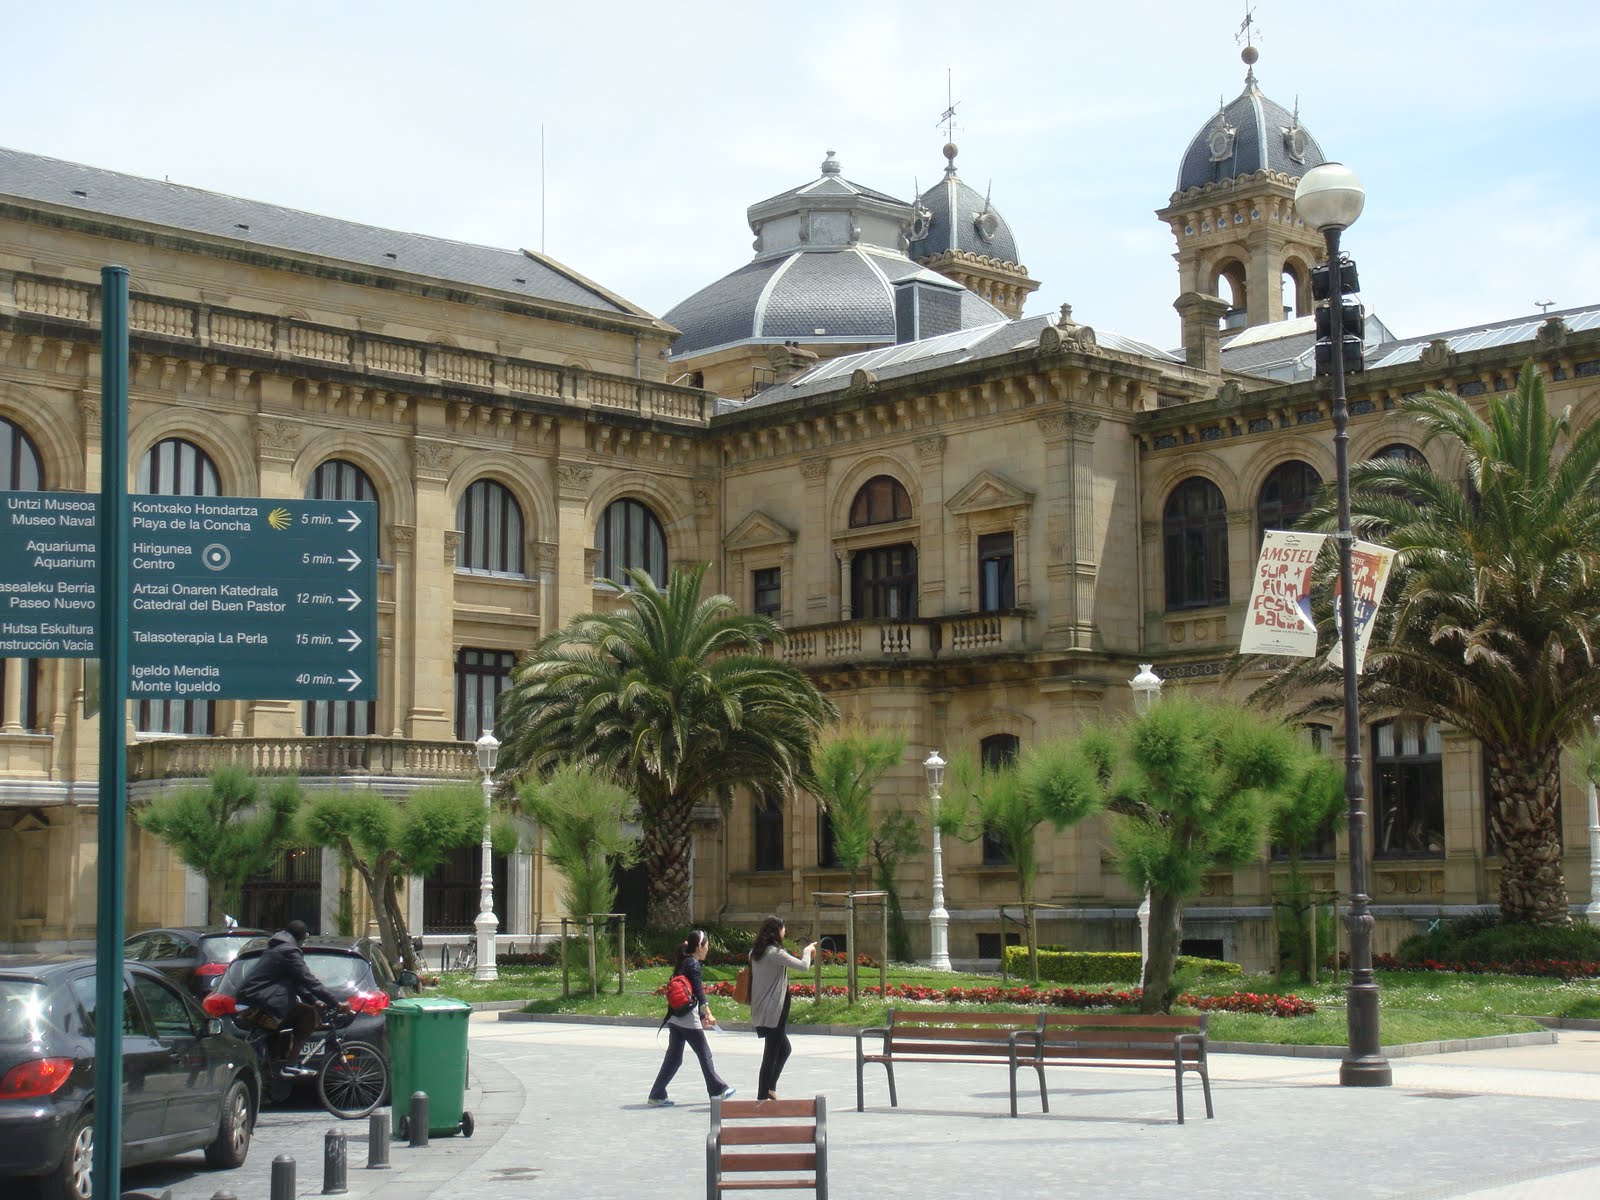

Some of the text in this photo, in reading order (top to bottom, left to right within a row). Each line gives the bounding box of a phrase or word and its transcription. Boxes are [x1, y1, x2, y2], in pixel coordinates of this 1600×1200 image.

[8, 498, 95, 510] Untzi Museoa
[133, 502, 258, 516] Kontxako Hondartza
[13, 514, 95, 526] Museo Naval
[133, 517, 251, 531] Playa de la Concha
[301, 514, 333, 524] 5 min.
[27, 540, 95, 553] Aquariuma
[134, 543, 192, 556] Hirigunea
[303, 553, 334, 564] 5 min.
[1260, 548, 1313, 564] AMSTEL
[34, 556, 95, 569] Aquarium
[133, 558, 175, 569] Centro
[58, 582, 95, 593] Berria
[133, 584, 278, 596] Artzai Onaren Katedrala
[10, 597, 95, 609] Paseo Nuevo
[297, 593, 334, 603] 12 min.
[133, 599, 286, 611] Catedral del Buen Pastor
[3, 623, 93, 634] Hutsa Eskultura
[133, 631, 268, 645] Talasoterapia La Perla
[297, 634, 333, 644] 15 min.
[63, 640, 93, 650] Vacía
[132, 665, 219, 678] Igeldo Mendia
[296, 674, 334, 684] 40 min.
[132, 681, 220, 694] Monte Igueldo
